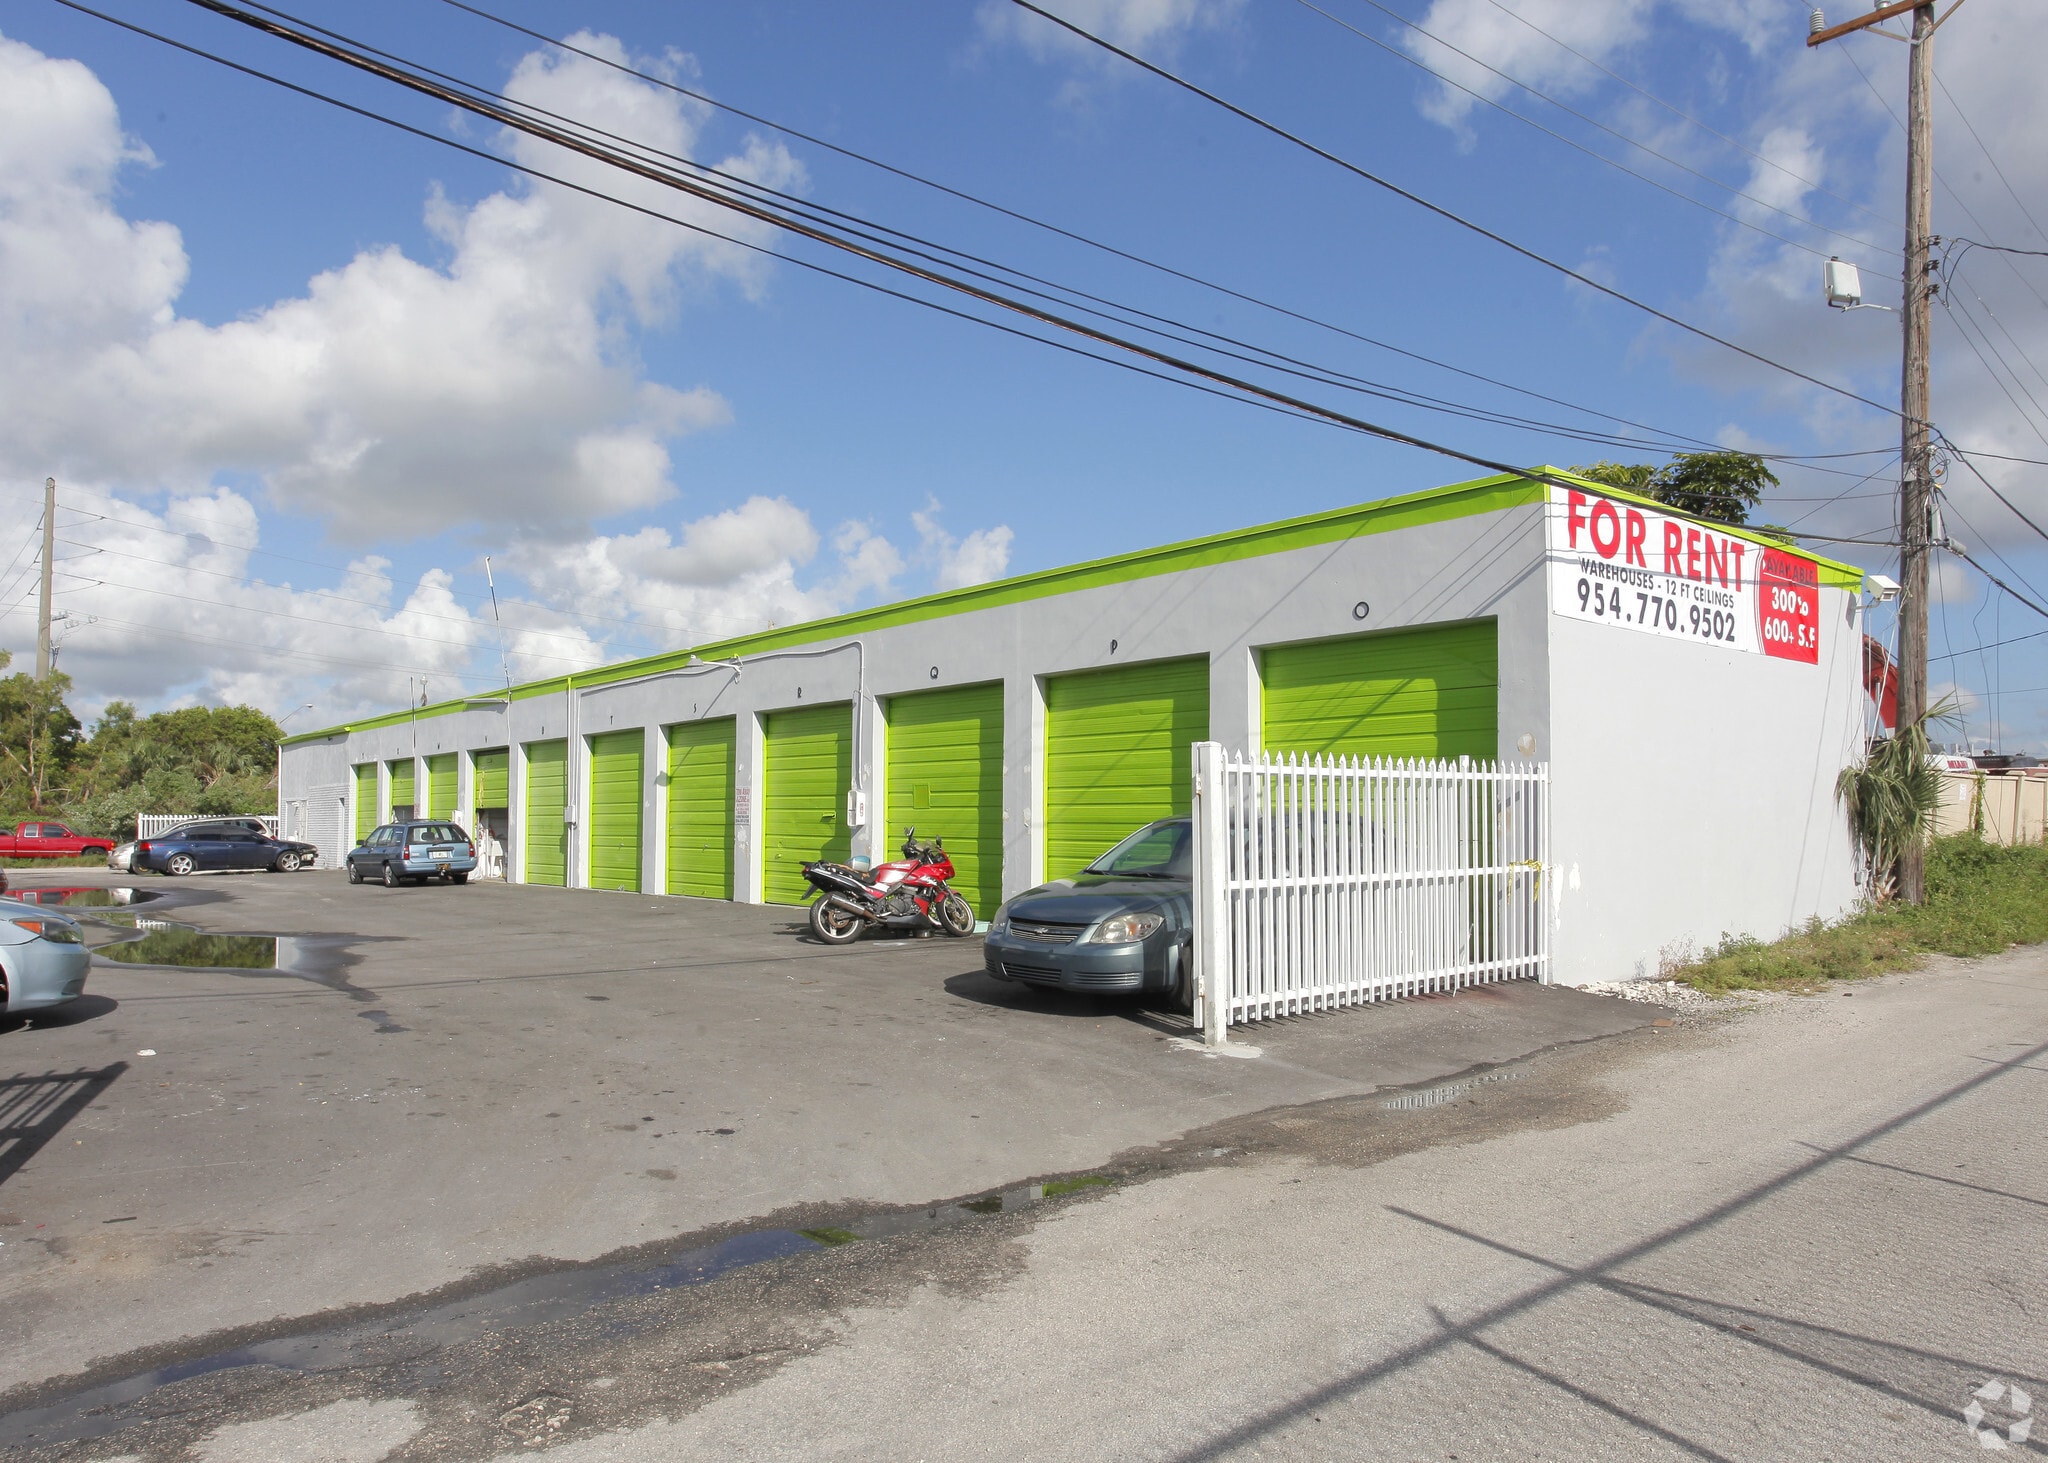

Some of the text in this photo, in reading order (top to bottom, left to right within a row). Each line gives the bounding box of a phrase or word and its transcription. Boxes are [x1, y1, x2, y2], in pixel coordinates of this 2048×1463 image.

[1568, 489, 1745, 592] FOR RENT
[1578, 556, 1654, 590] WAREHOUSES
[1666, 579, 1677, 596] 12
[1680, 583, 1690, 599] FT
[1694, 586, 1735, 609] CEILINGS
[1354, 601, 1370, 620] O
[1577, 577, 1735, 642] 954.770.9502
[1771, 586, 1797, 614] 300
[1764, 616, 1794, 644] 600+
[1109, 638, 1119, 656] P
[929, 665, 939, 681] Q
